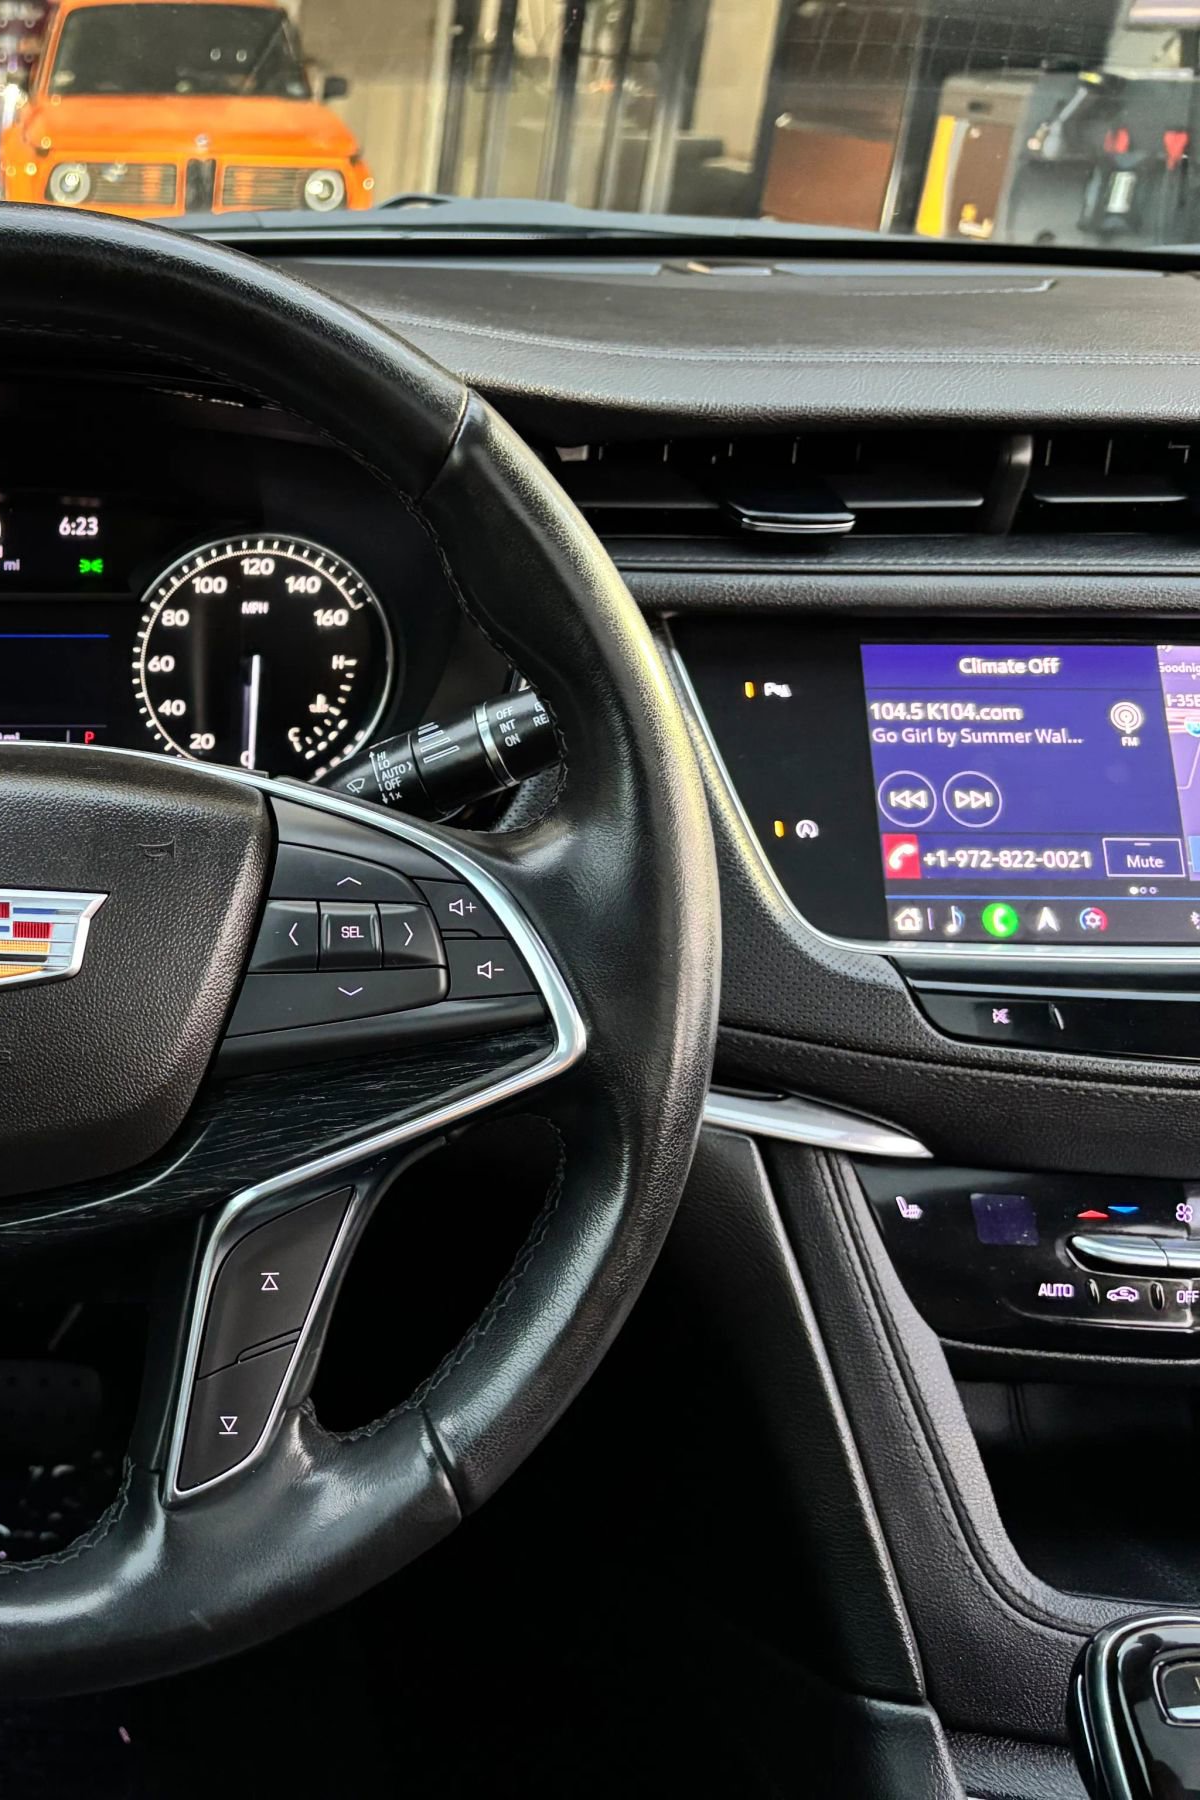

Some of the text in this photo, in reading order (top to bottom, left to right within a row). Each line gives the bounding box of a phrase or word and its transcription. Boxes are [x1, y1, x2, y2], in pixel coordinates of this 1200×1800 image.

[58, 516, 99, 536] 6:23
[3, 559, 20, 571] mi
[240, 557, 276, 576] 120
[191, 576, 228, 595] 100
[285, 576, 322, 595] 140
[241, 602, 269, 615] MPH
[161, 609, 190, 627] 80
[313, 609, 349, 627] 160
[147, 655, 175, 672] 60
[958, 656, 1060, 675] Climate Off
[158, 700, 186, 717] 40
[496, 706, 514, 720] OFF
[869, 702, 1022, 722] 104.5 K104.com
[499, 718, 517, 733] INT
[84, 731, 95, 744] P
[189, 733, 216, 750] 20
[504, 732, 521, 747] ON
[872, 726, 1083, 747] Go Girl by Summer Wal...
[1121, 737, 1140, 747] FM
[377, 752, 386, 762] HI
[378, 760, 390, 769] LO
[381, 765, 406, 781] AUTO
[385, 778, 402, 792] OFF
[923, 850, 1092, 869] +1-972-822-0021
[1126, 854, 1165, 868] Mute
[341, 925, 364, 939] SEL
[1038, 1283, 1075, 1297] AUTO
[1176, 1290, 1199, 1304] OFF
